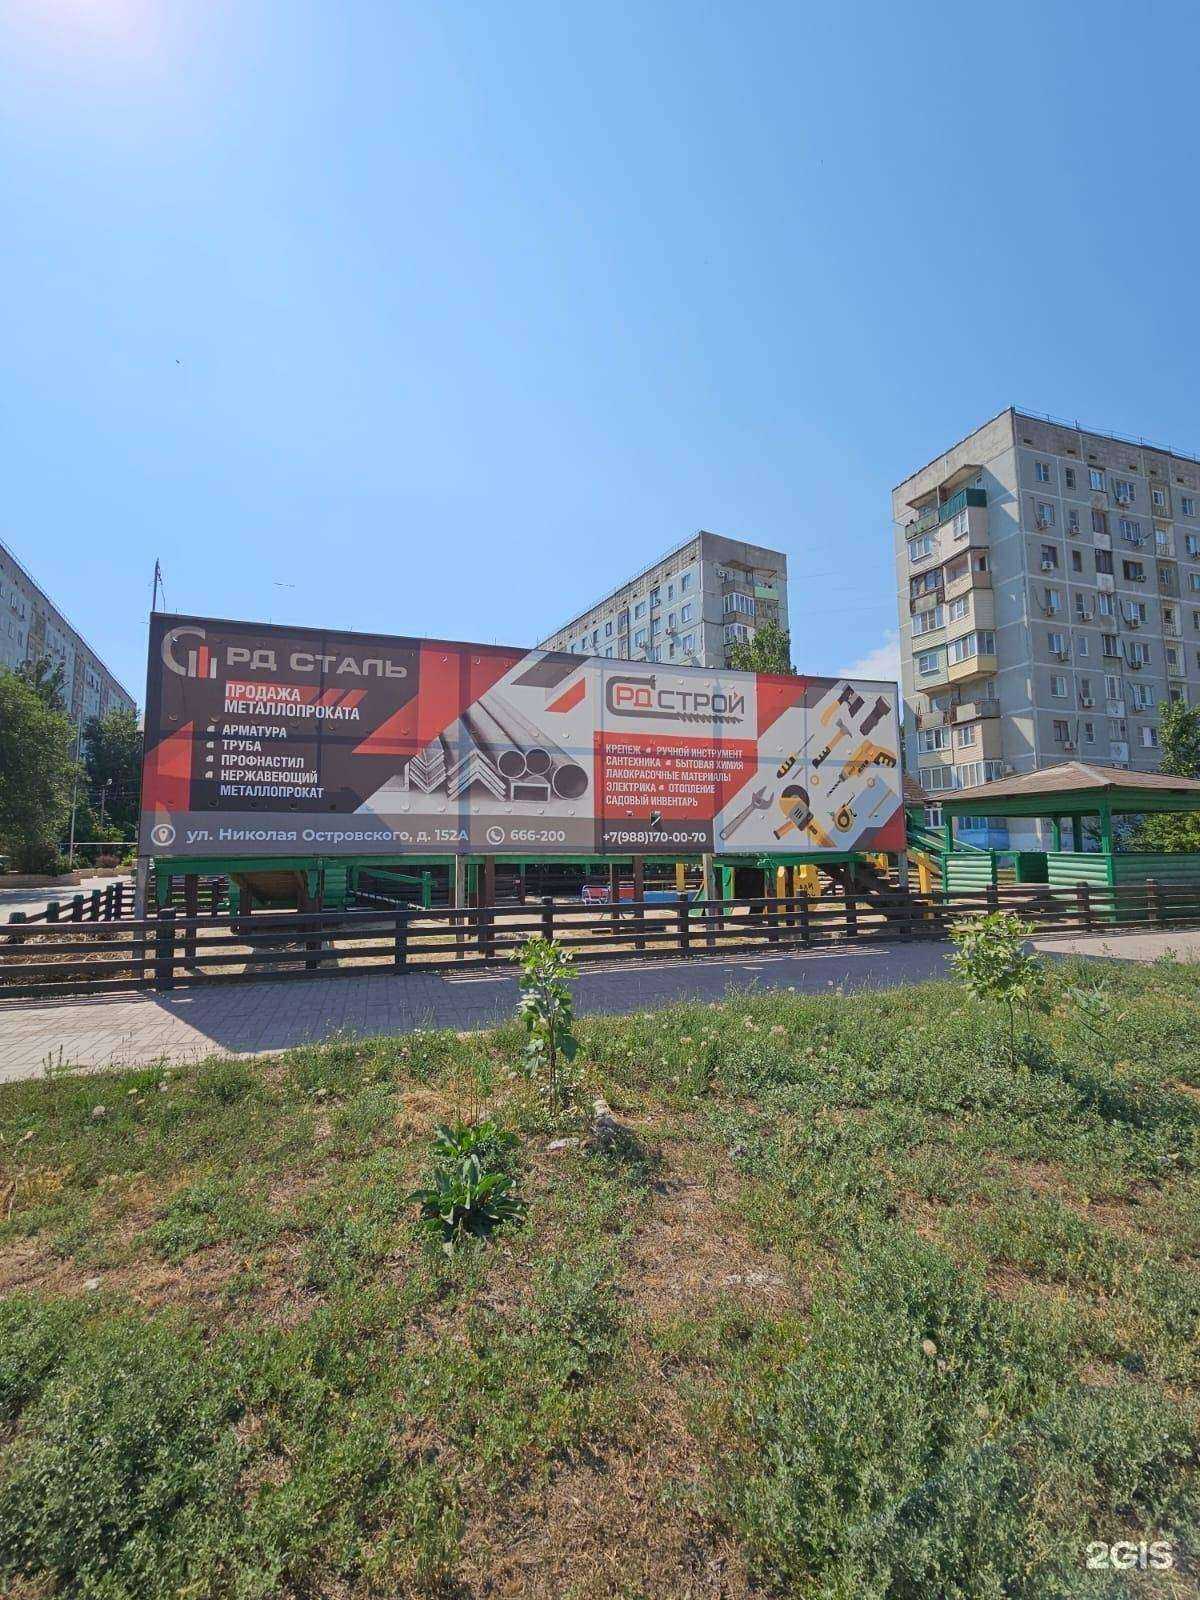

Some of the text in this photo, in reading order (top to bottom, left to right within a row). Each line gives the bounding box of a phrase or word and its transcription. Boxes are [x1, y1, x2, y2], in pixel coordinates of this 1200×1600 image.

[226, 647, 408, 678] РД СТАЛЬ
[225, 683, 301, 702] ПРОДАЖА
[224, 700, 360, 720] МЕТАЛЛОПРОКАТА
[222, 724, 287, 738] АРМАТУРА
[222, 740, 262, 752] ТРУБА
[605, 744, 743, 758] КРЕПЕЖ РУЧНОЙ ИНСТРУМЕНТ
[221, 754, 305, 769] ПРОФНАСТИЛ
[605, 756, 744, 770] САНТЕХНИКА БЫТОВАЯ ХИМИЯ
[220, 769, 318, 784] НЕРЖАВЕЮЩИЙ
[605, 769, 731, 782] ЛАКОКРАСОЧНЫЕ МАТЕРИАЛЫ
[220, 785, 324, 799] МЕТАЛЛОПРОКАТ
[606, 782, 715, 794] ЭЛЕКТРИКА ОТОПЛЕНИЕ
[605, 794, 698, 807] САДОВЫЙ ИНВЕНТАРЬ
[186, 830, 213, 844] ул.
[219, 829, 297, 842] Николая
[302, 829, 413, 843] Островского,
[416, 831, 432, 843] д.
[510, 830, 566, 842] 666-200
[602, 830, 707, 845] +7(988)170-00-70
